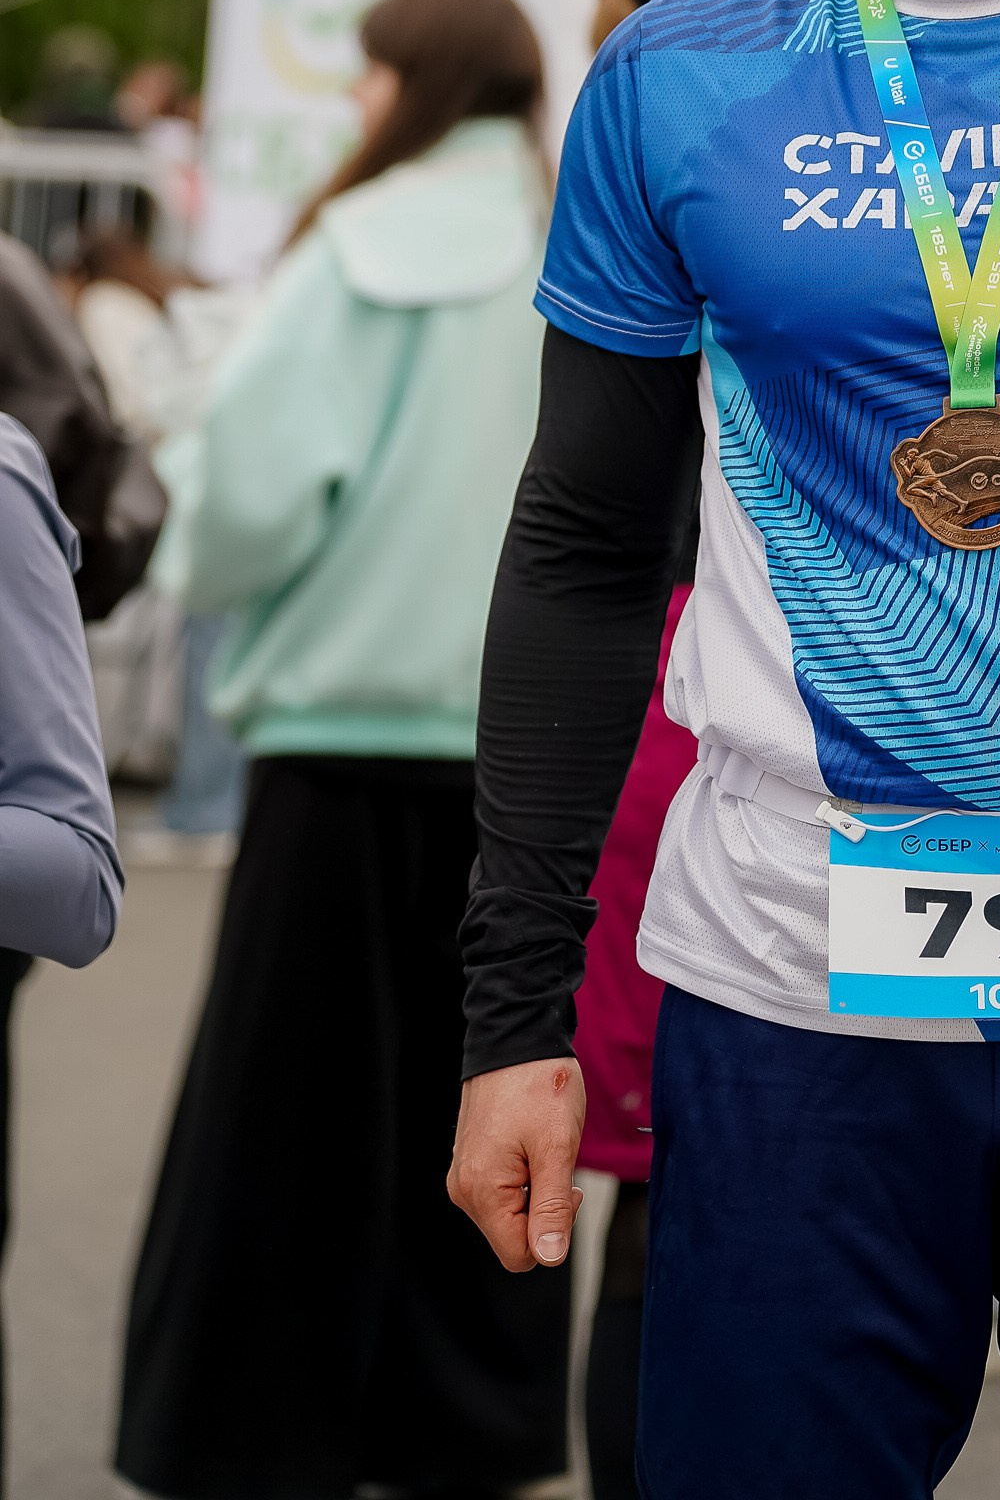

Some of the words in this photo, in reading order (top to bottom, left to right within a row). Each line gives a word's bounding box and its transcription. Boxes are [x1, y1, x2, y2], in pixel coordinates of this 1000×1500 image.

[888, 74, 907, 106] Utair
[912, 162, 936, 206] СБЕР
[929, 225, 948, 256] 185
[939, 261, 955, 291] лет
[973, 338, 983, 378] марафон
[925, 838, 971, 852] СБЕР
